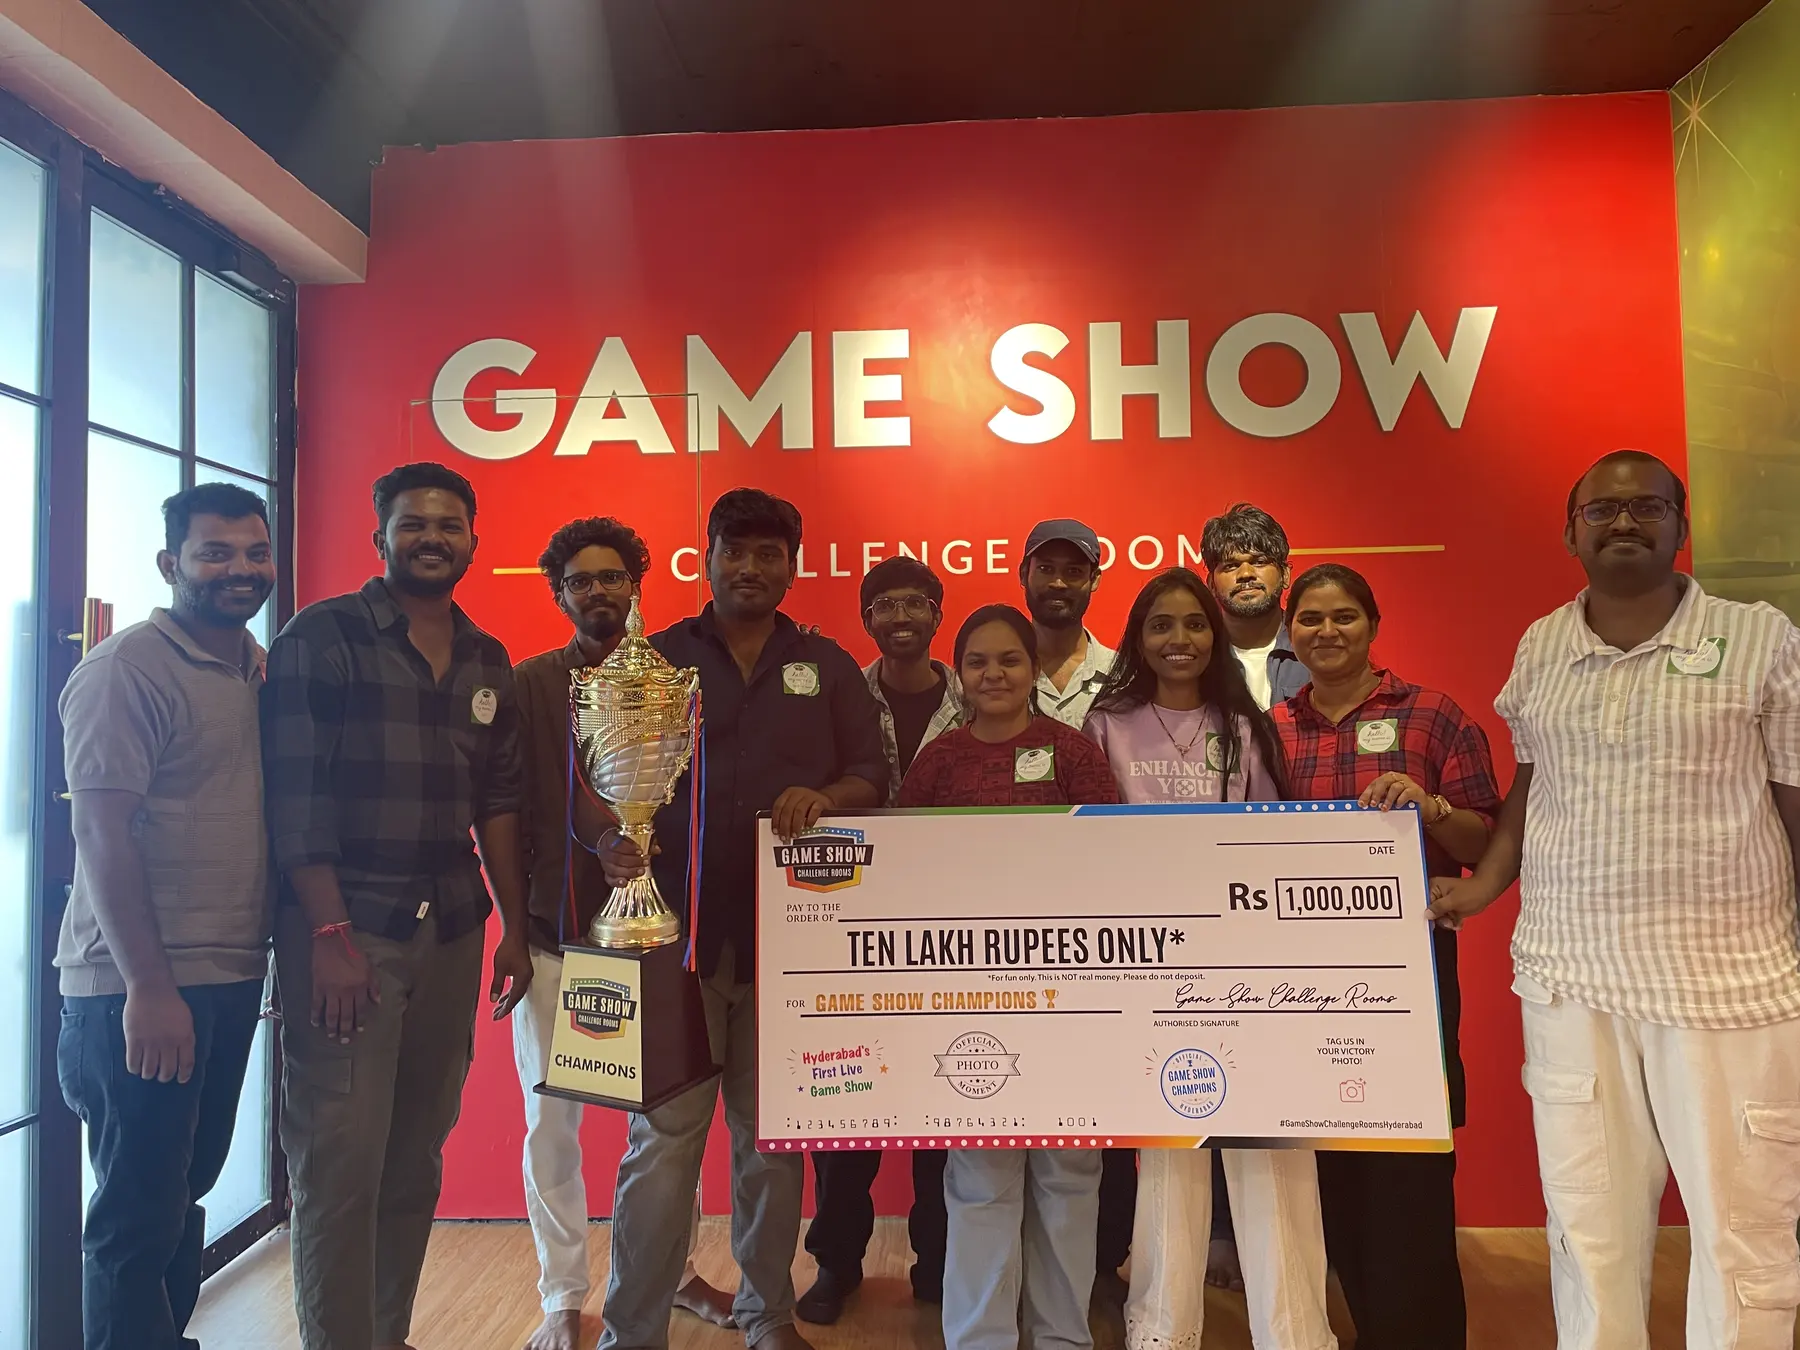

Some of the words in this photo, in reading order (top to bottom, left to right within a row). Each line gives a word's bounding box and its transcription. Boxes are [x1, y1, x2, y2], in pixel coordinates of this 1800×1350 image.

[432, 329, 911, 460] GAME
[987, 306, 1498, 444] SHOW
[671, 539, 1010, 582] CLLENGE
[1130, 760, 1221, 778] ENHANC
[781, 847, 820, 864] GAME
[826, 846, 866, 863] SHOW
[1369, 846, 1395, 855] DATE
[797, 869, 829, 878] CHALLENGE
[831, 868, 852, 877] ROOMS
[1228, 882, 1269, 911] Rs
[1285, 885, 1394, 915] 1,000,000
[786, 904, 804, 912] PAY
[806, 903, 819, 912] TO
[822, 903, 841, 911] THE
[786, 914, 819, 923] ORDER
[821, 913, 835, 922] OF
[847, 930, 895, 966] TEN
[905, 929, 974, 966] LAKH
[984, 928, 1089, 965] RUPEES
[1018, 974, 1037, 983] only.
[1037, 973, 1053, 981] This
[1054, 973, 1060, 981] is
[1079, 973, 1094, 981] real
[1094, 974, 1122, 983] money.
[1123, 973, 1147, 981] Please
[1174, 972, 1206, 982] deposit.
[786, 1000, 805, 1008] FOR
[815, 993, 865, 1013] GAME
[872, 992, 925, 1012] SHOW
[931, 990, 1037, 1011] CHAMPIONS
[1175, 982, 1216, 1009] Game
[1219, 982, 1264, 1009] Show
[1268, 982, 1341, 1011] Challenge
[1344, 982, 1397, 1009] Rooms
[567, 992, 597, 1012] GAME
[600, 997, 632, 1018] SHOW
[578, 1014, 602, 1026] CHALLENGE
[602, 1018, 619, 1028] ROOMS
[1153, 1020, 1199, 1028] AUTHORISED
[955, 1036, 996, 1050] OFFICIAL
[1325, 1037, 1342, 1045] TAG
[1343, 1037, 1354, 1045] US
[1356, 1037, 1365, 1045] IN
[802, 1045, 870, 1065] Hyderabad's
[1317, 1047, 1340, 1055] YOUR
[1340, 1047, 1375, 1055] VICTORY
[554, 1053, 637, 1080] CHAMPIONS
[957, 1060, 999, 1070] PHOTO
[1331, 1057, 1363, 1065] PHOTO!
[812, 1066, 837, 1080] First
[840, 1064, 863, 1076] Live
[1168, 1069, 1191, 1082] GAME
[1192, 1067, 1216, 1080] SHOW
[810, 1085, 841, 1097] Game
[844, 1080, 873, 1093] Show
[957, 1080, 997, 1095] MOMENT
[1171, 1081, 1217, 1096] CHAMPIONS
[1280, 1119, 1423, 1131] #GameShowChallengeRoomsHyderabad
